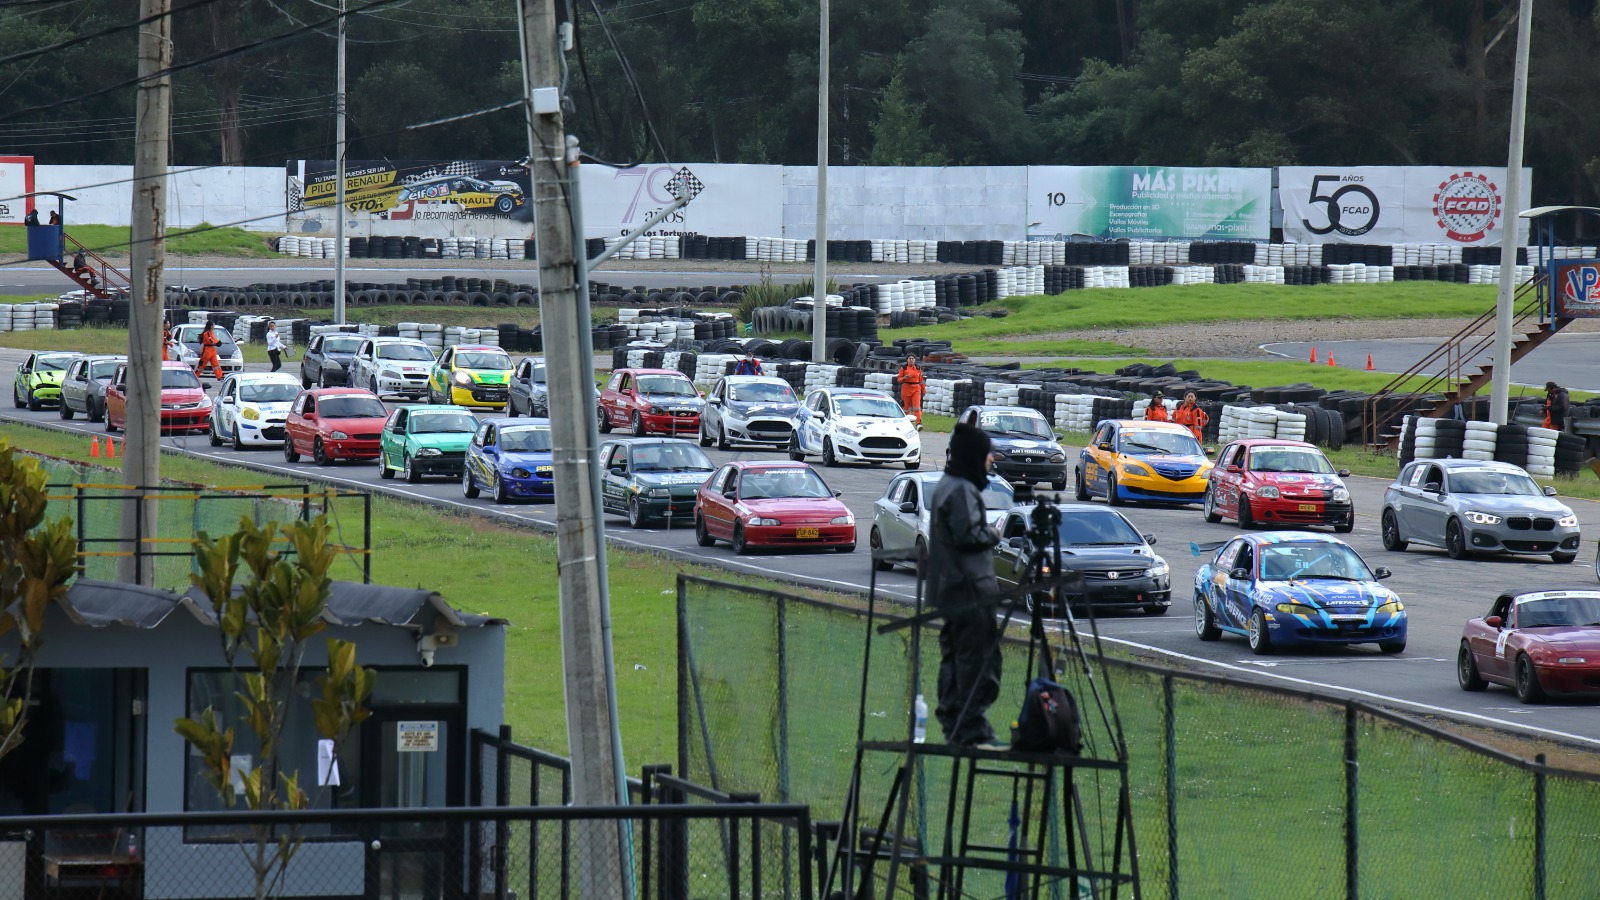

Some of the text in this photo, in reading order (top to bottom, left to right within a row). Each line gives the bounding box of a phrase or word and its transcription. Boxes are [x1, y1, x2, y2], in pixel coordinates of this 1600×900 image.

[345, 169, 367, 178] PUEDES
[1341, 174, 1364, 183] AÑOS
[311, 173, 390, 195] PILOT RENAULT
[1132, 171, 1176, 191] MÁS
[1047, 192, 1066, 207] 10
[1132, 191, 1169, 199] Publicidad
[1303, 175, 1380, 236] 50
[1342, 207, 1370, 215] FCAD
[1445, 200, 1489, 211] FCAD
[1566, 266, 1599, 302] VP
[980, 415, 998, 424] 412
[1225, 597, 1248, 625] LATEFACE
